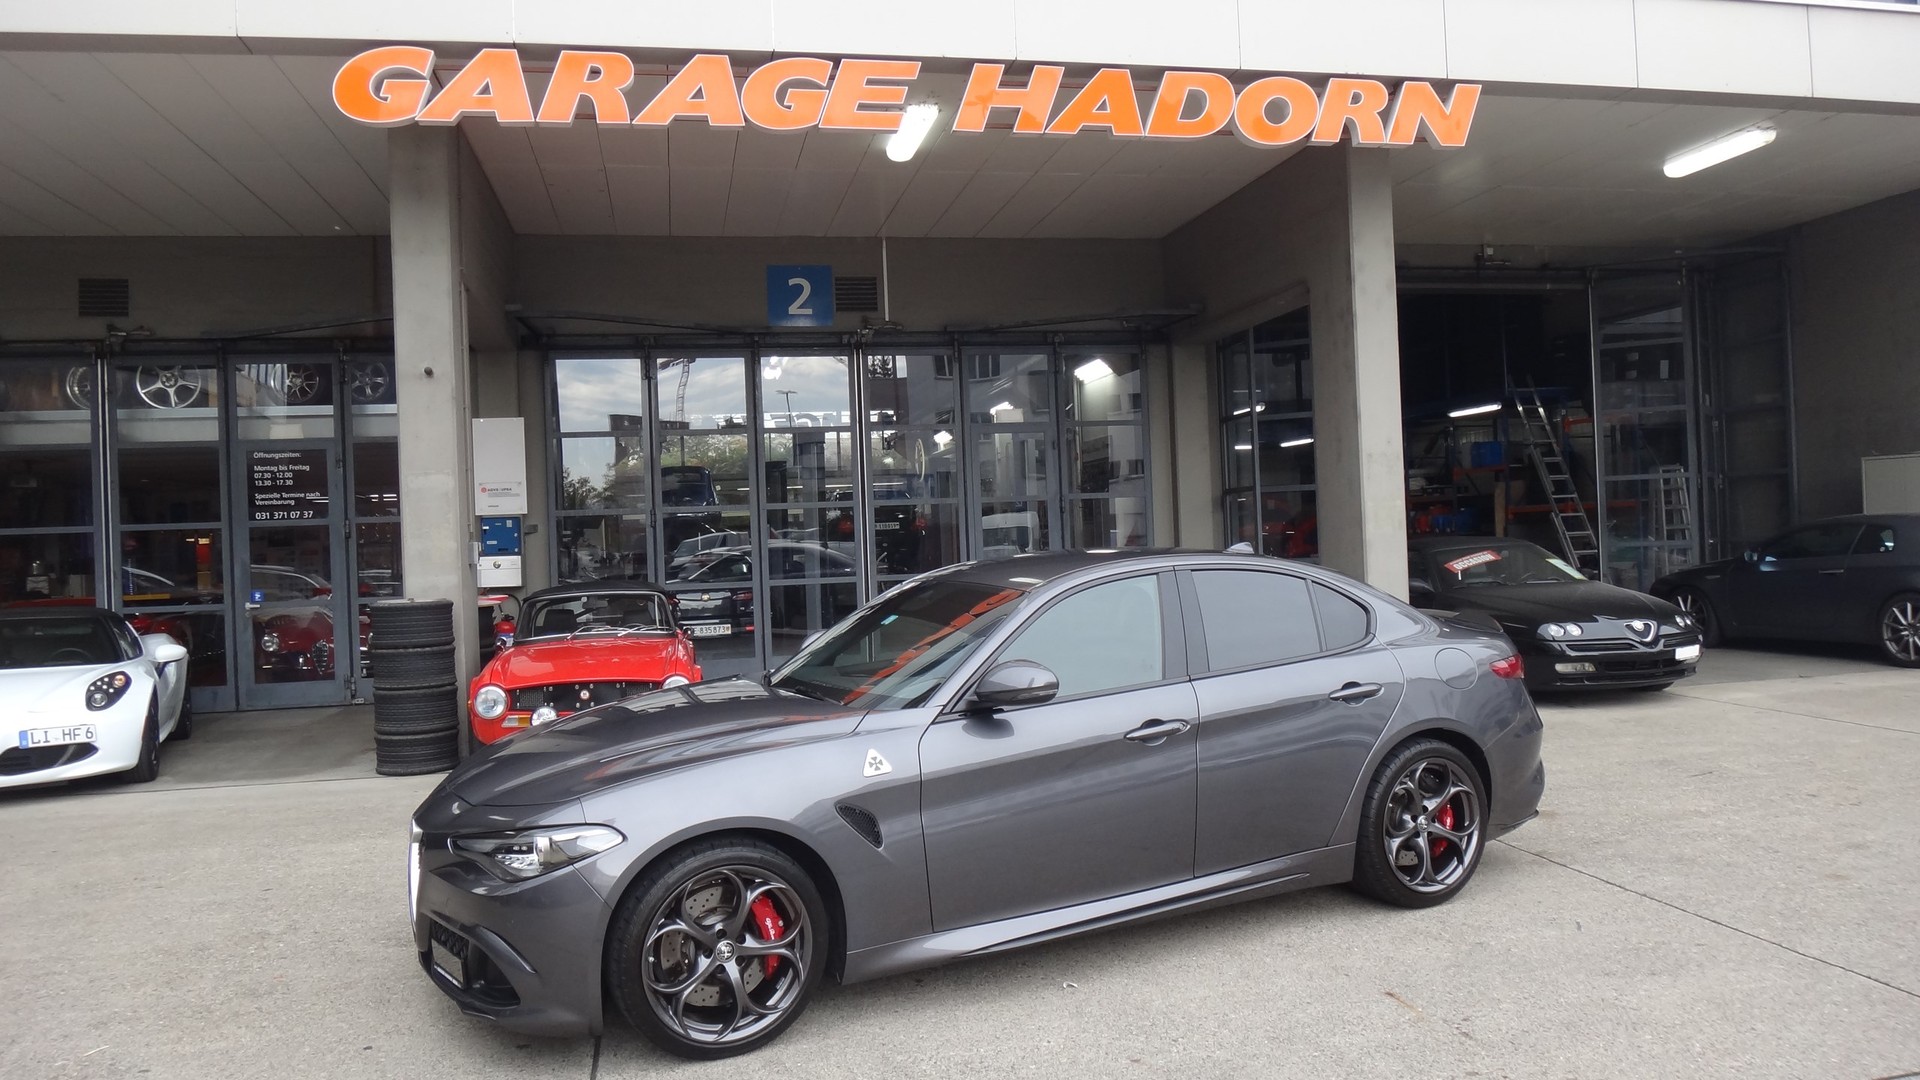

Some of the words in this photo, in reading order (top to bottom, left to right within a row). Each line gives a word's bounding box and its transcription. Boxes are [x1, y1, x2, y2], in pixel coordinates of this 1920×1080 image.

[332, 46, 922, 131] GARAGE
[952, 62, 1482, 148] HADORN
[788, 277, 813, 315] 2
[253, 452, 302, 460] Öffnungszeiten:
[289, 464, 310, 472] Freitag
[255, 512, 270, 520] 031
[273, 511, 288, 519] 371
[290, 511, 300, 519] 07
[303, 510, 314, 519] 37
[1453, 553, 1496, 570] OCCASION
[30, 730, 51, 745] LI
[62, 727, 82, 742] HF
[85, 726, 94, 740] 6
